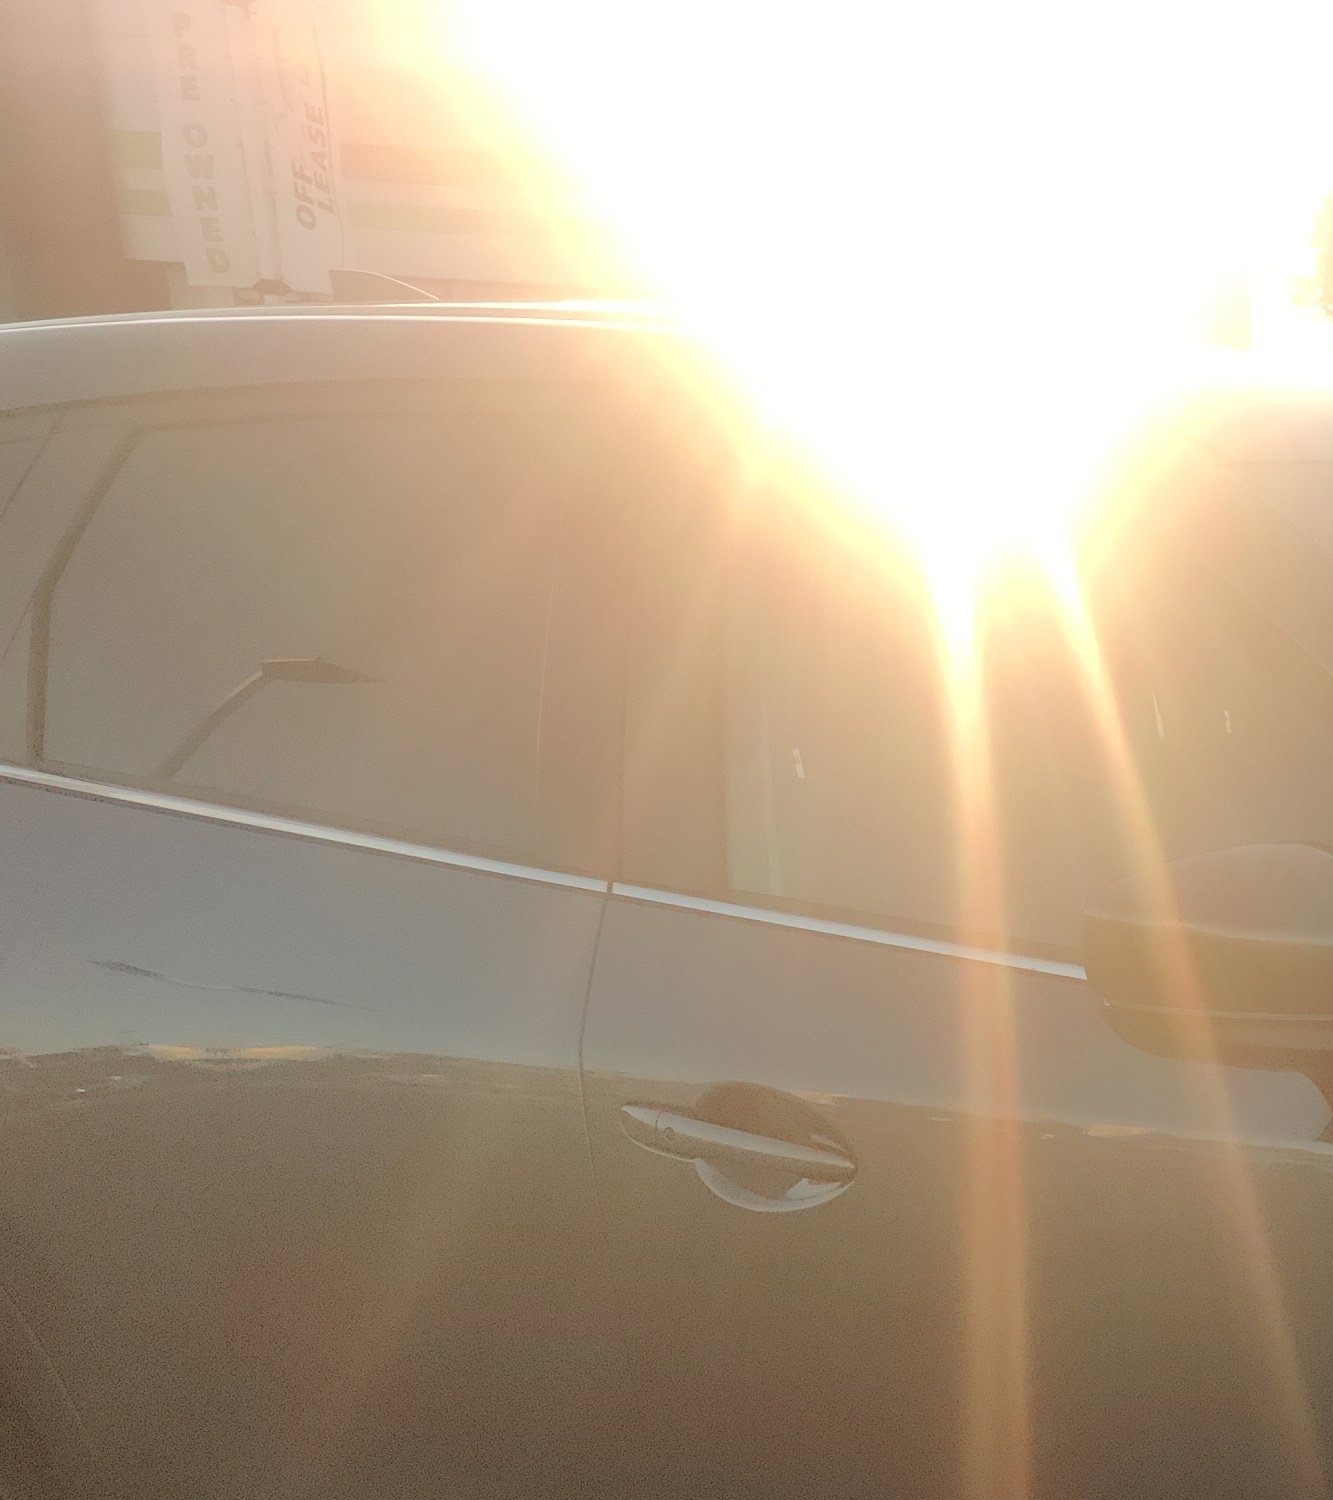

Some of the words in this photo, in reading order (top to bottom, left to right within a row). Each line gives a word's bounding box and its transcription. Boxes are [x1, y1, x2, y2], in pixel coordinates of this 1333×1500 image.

[184, 124, 230, 274] OWNED
[291, 160, 317, 231] OFF
[306, 102, 333, 214] LEASE
